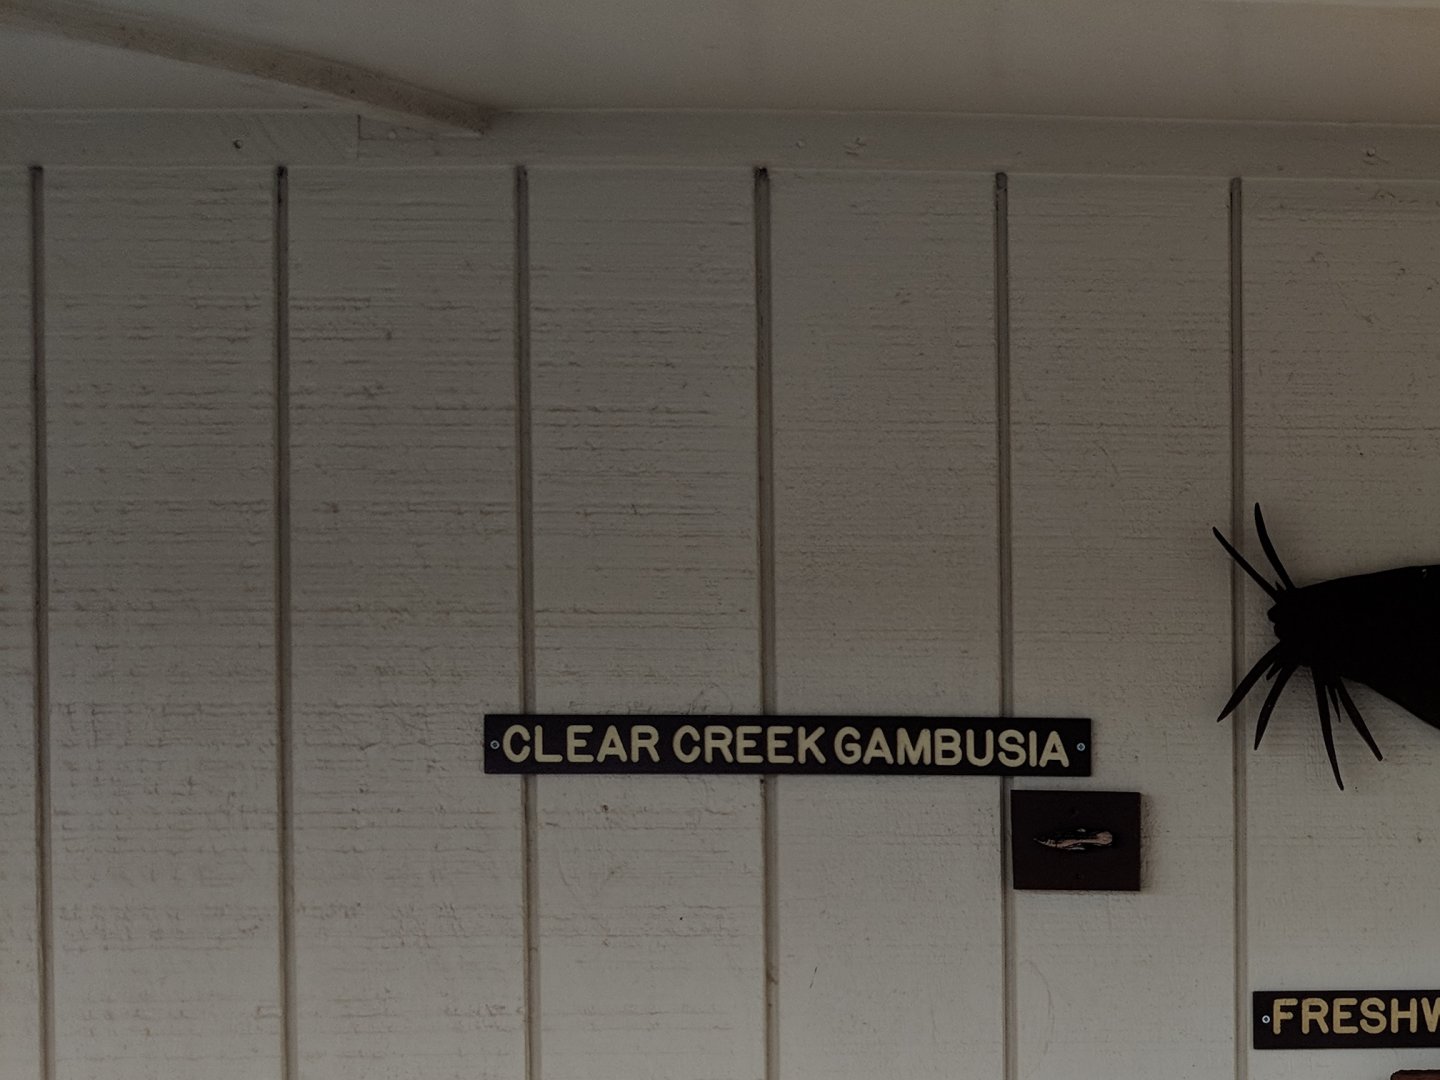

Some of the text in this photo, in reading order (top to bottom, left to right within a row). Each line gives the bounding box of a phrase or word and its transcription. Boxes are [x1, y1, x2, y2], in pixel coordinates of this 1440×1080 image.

[502, 724, 1070, 768] CLEAR CREEK GAMBUSIA
